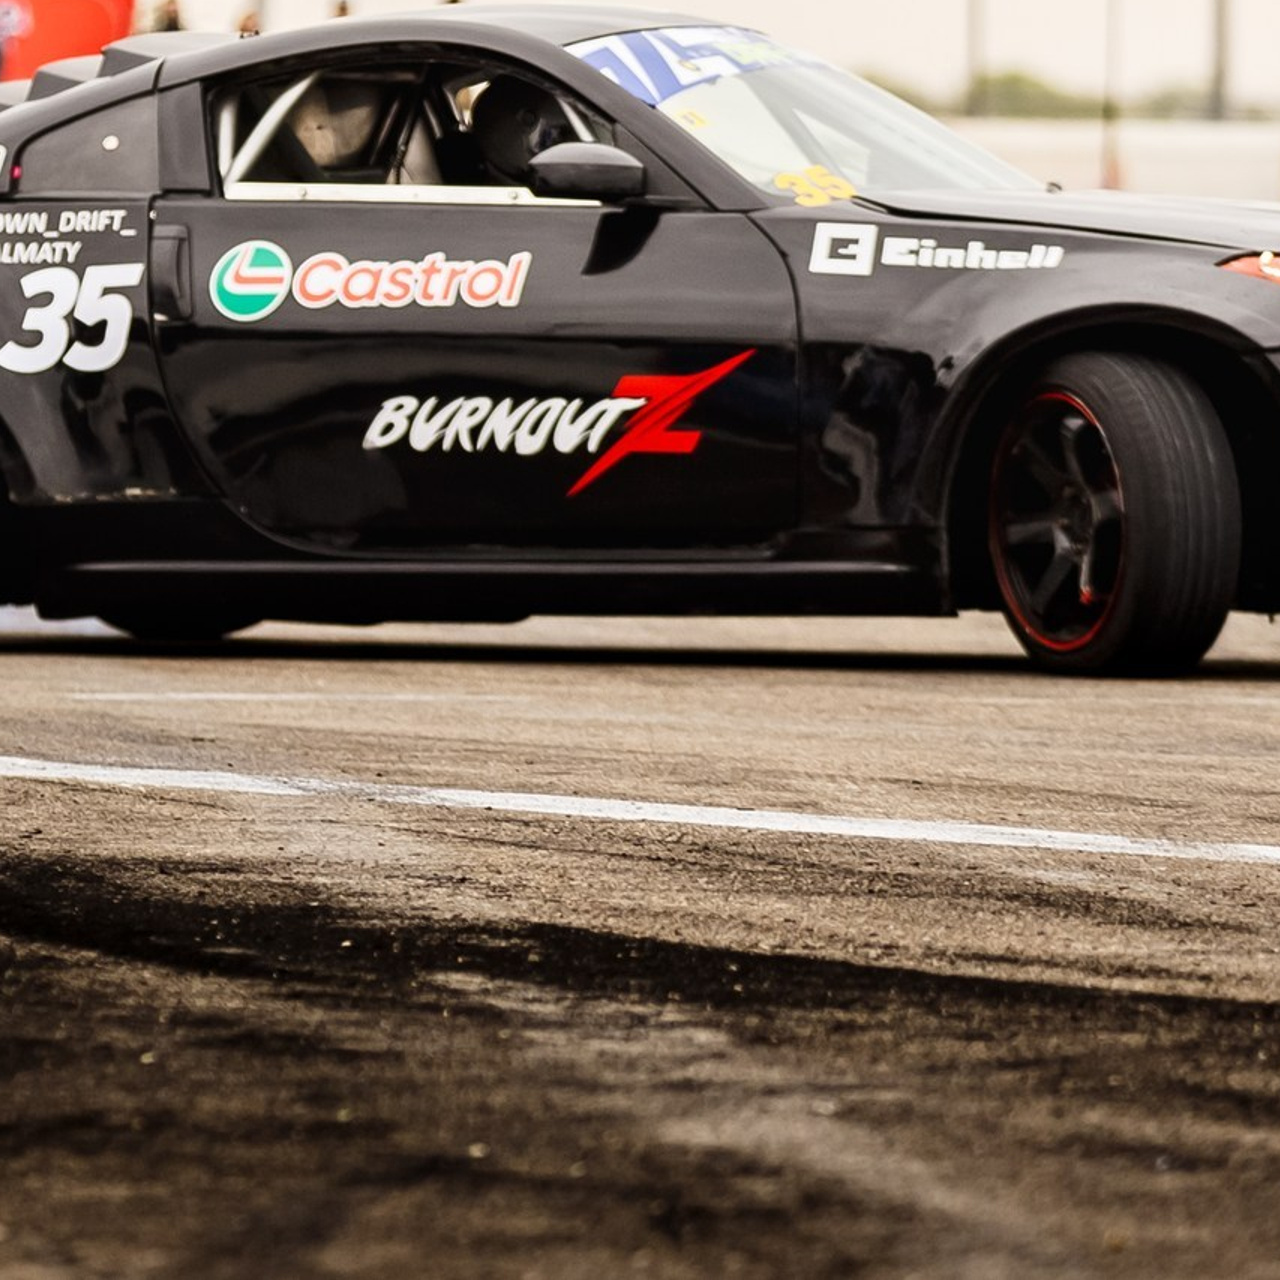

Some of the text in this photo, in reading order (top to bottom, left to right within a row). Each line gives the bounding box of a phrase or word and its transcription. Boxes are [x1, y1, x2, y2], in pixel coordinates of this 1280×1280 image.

[774, 164, 858, 208] 35
[880, 236, 1065, 270] Einhell
[292, 251, 532, 308] Castrol
